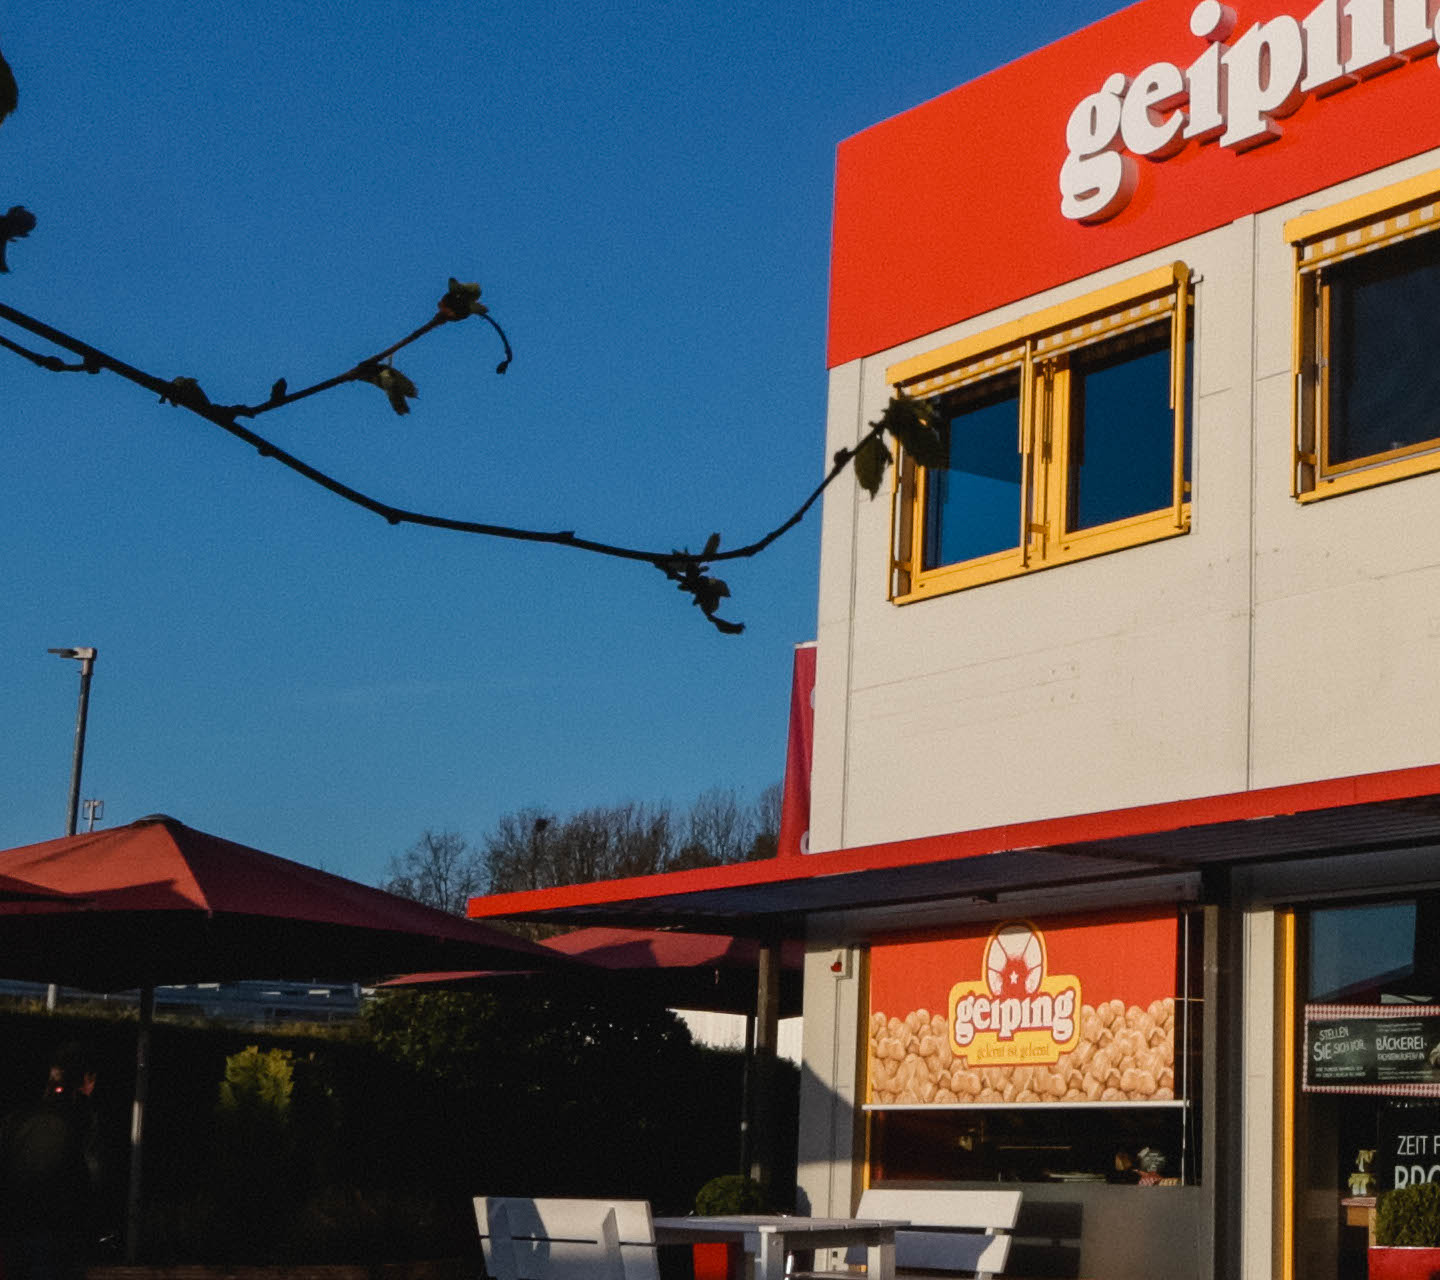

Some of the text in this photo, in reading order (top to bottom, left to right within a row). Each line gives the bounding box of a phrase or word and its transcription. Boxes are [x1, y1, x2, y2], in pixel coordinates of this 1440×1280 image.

[954, 988, 1076, 1046] geiping
[1319, 1026, 1349, 1041] STELLEN
[1375, 1035, 1428, 1051] BÄCKEREI-
[1313, 1041, 1332, 1062] SIE
[1397, 1134, 1429, 1156] ZEIT
